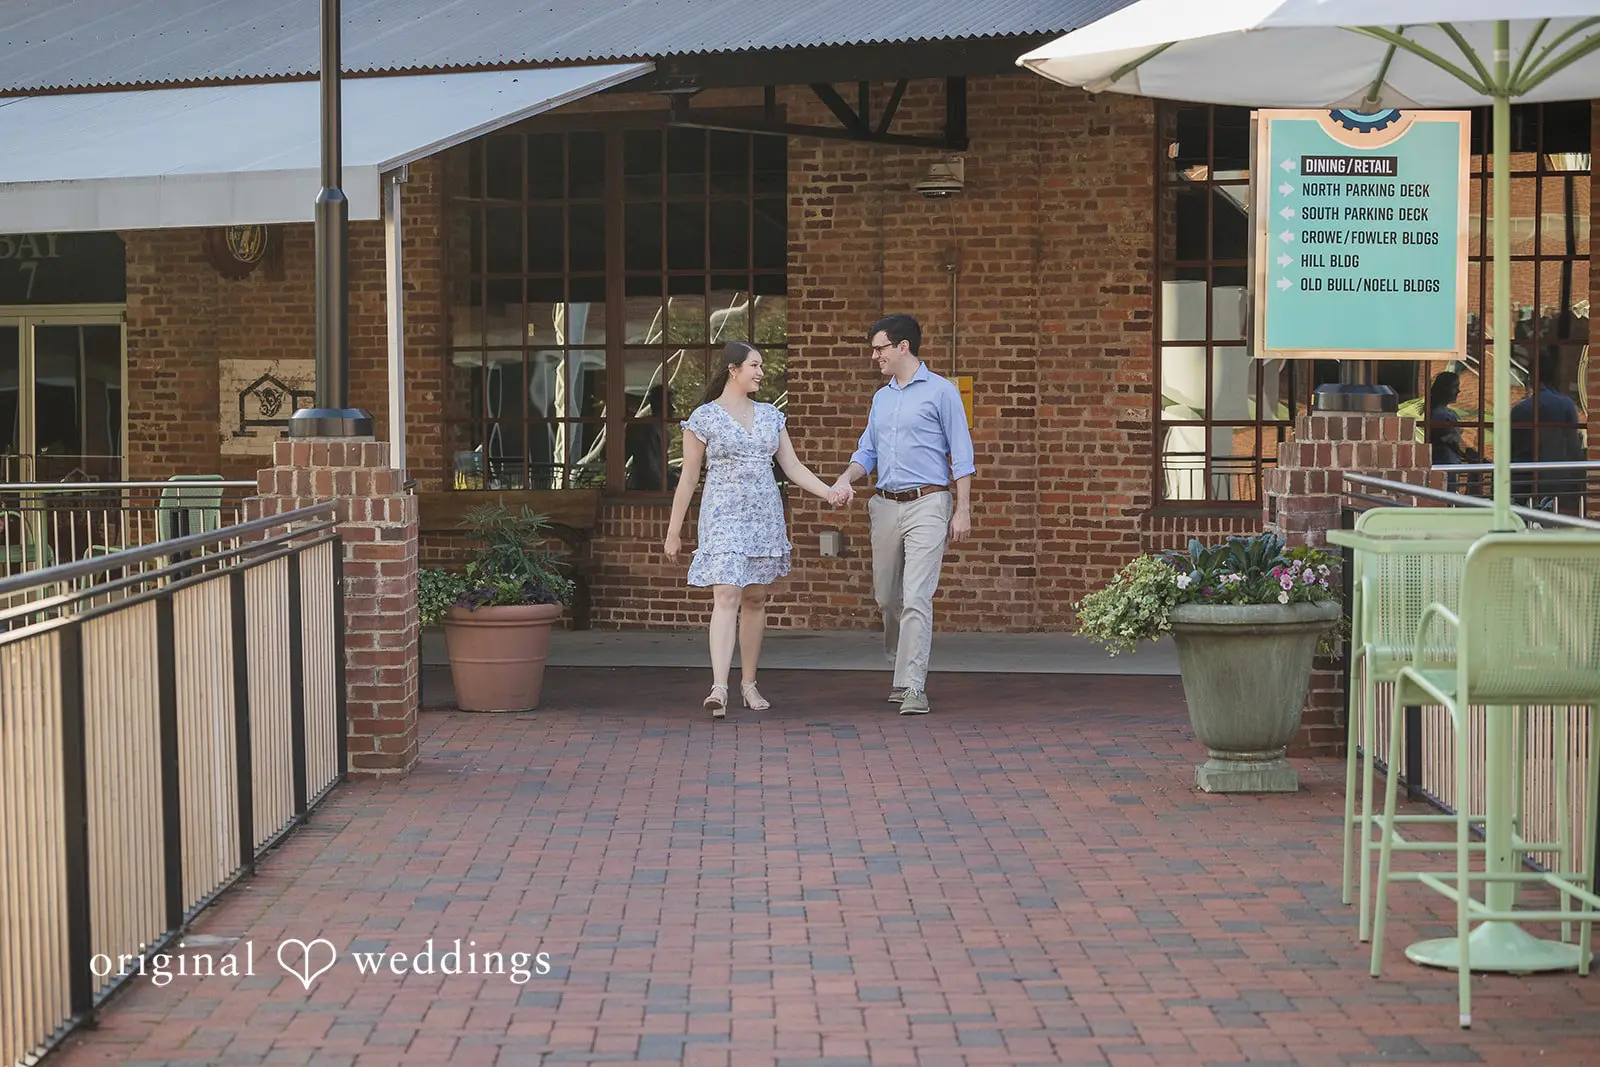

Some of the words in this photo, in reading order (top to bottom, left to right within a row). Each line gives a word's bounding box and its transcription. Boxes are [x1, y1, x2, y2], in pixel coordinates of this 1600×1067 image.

[1305, 159, 1393, 174] DINING/RETAIL
[1302, 183, 1341, 196] NORTH
[1345, 183, 1395, 197] PARKING
[1400, 184, 1430, 197] DECK
[1301, 206, 1339, 220] SOUTH
[1344, 207, 1394, 221] PARKING
[1399, 208, 1429, 221] DECK
[1301, 230, 1397, 244] CROWE/FOWLER
[1402, 231, 1439, 245] BLDGS
[1300, 254, 1325, 268] HILL
[1330, 254, 1359, 268] BLDG
[19, 261, 39, 299] 7
[1300, 277, 1322, 291] OLD
[1327, 277, 1399, 292] BULL/NOELL
[1403, 279, 1440, 292] BLDGS
